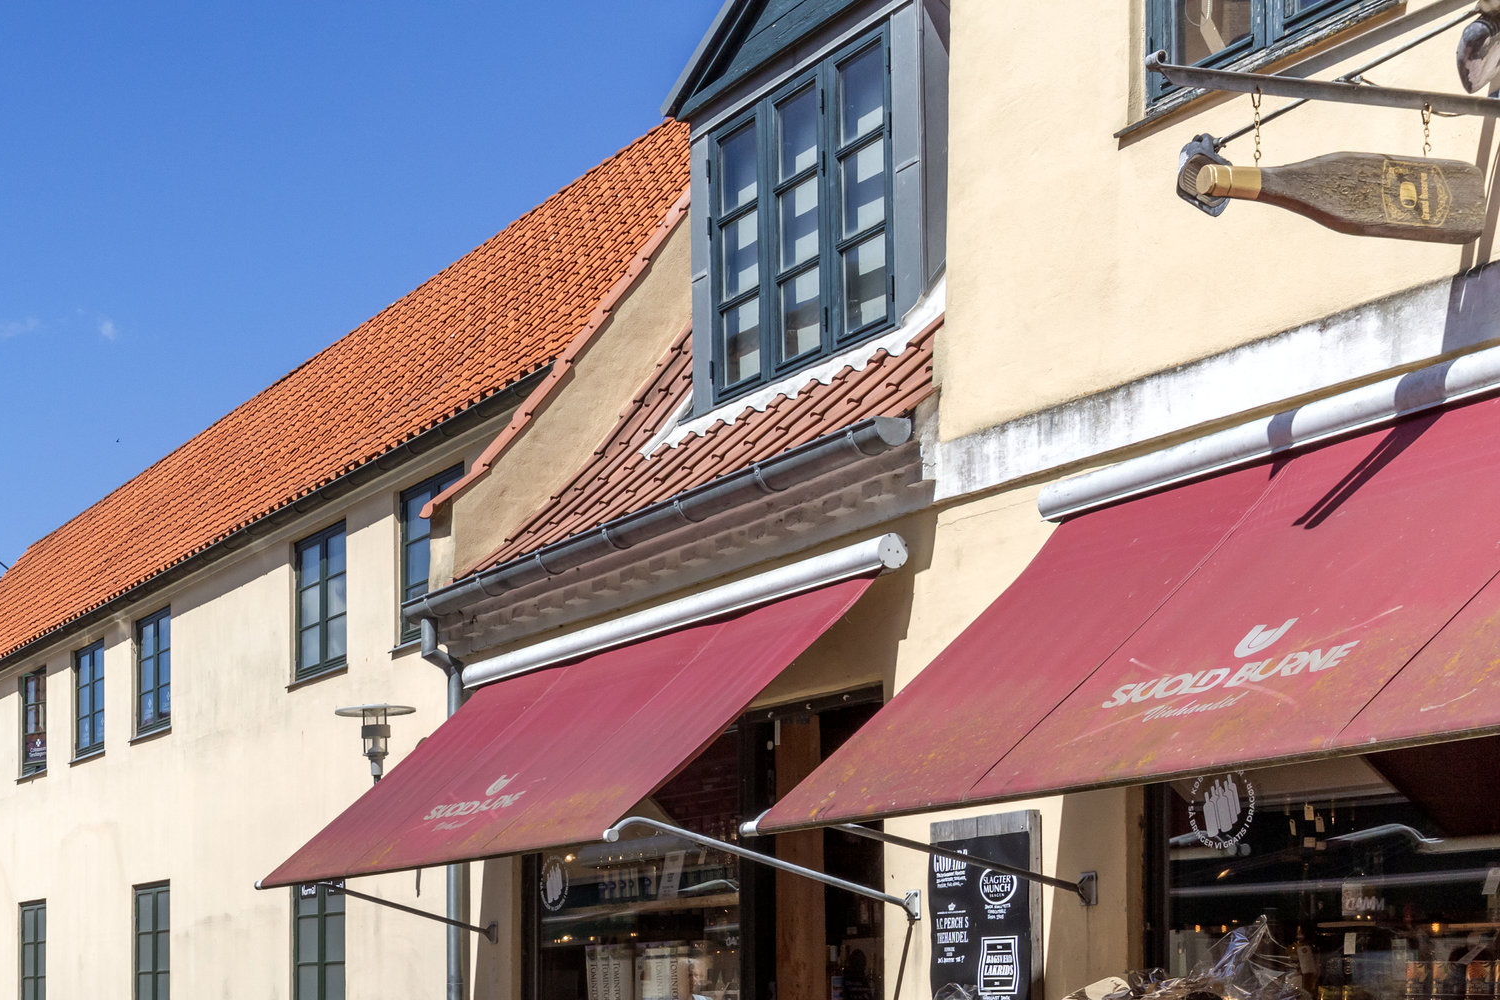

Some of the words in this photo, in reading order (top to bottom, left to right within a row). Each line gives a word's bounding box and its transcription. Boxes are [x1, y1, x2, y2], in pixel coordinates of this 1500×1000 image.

[1223, 639, 1361, 688] BURNE
[1189, 819, 1214, 849] BRINGER
[1222, 826, 1247, 848] GRATIS
[983, 874, 1011, 884] SLAGTER
[983, 883, 1011, 893] MUNCH
[984, 965, 1014, 976] LAKRIDS
